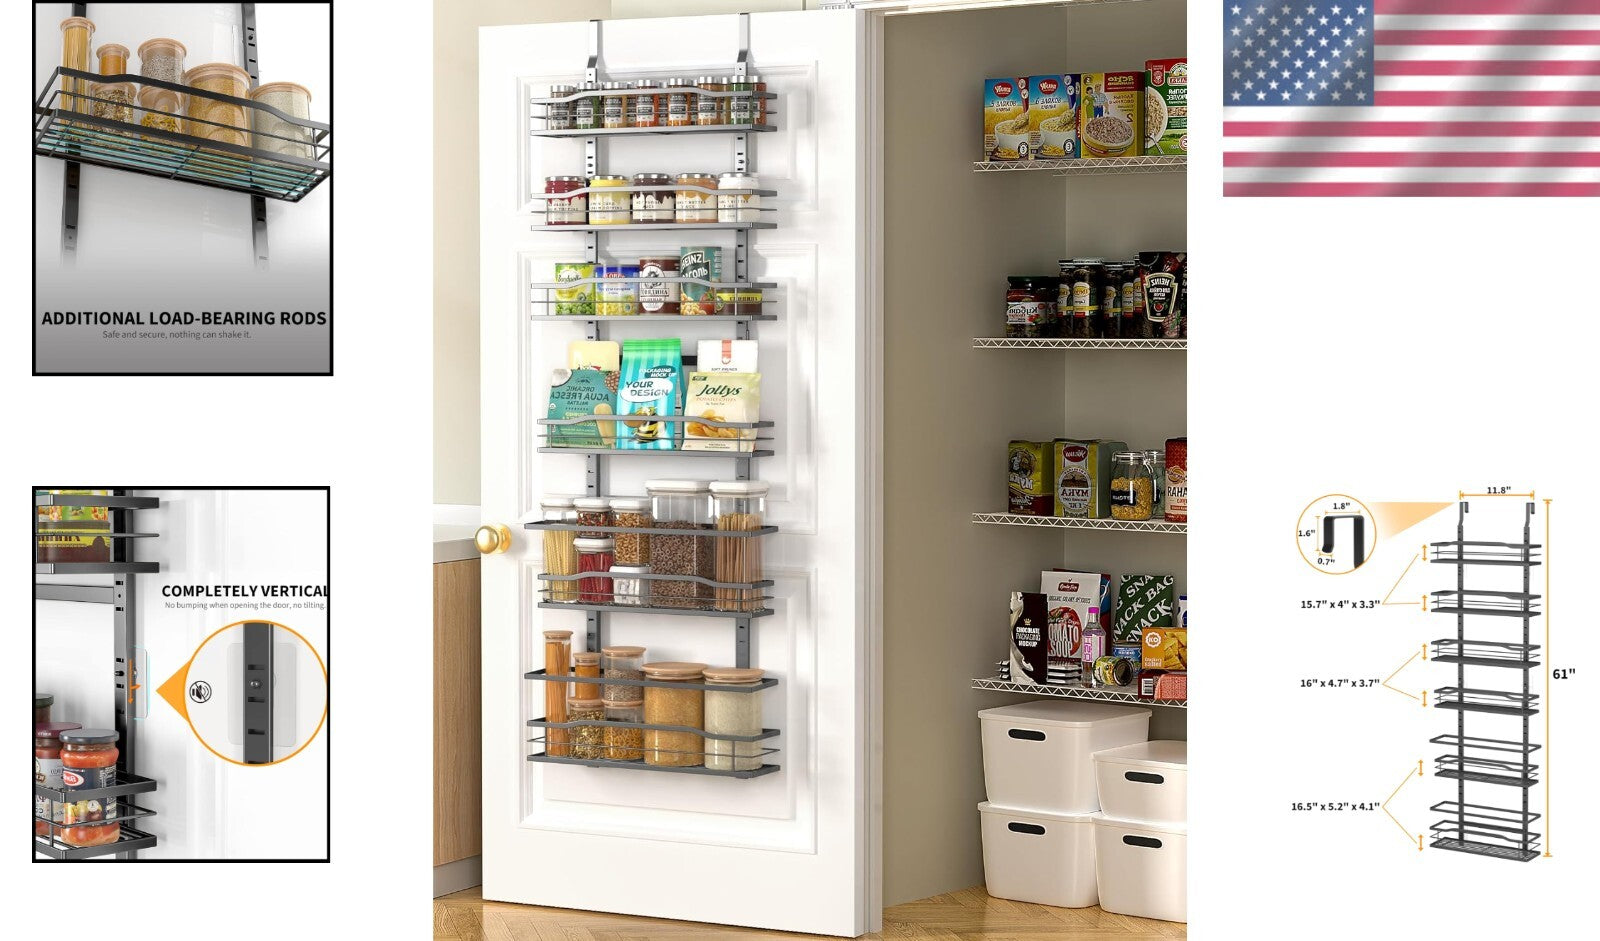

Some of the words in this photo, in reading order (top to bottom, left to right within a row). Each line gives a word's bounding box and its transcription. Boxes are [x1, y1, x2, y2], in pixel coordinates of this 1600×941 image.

[696, 384, 743, 398] Jollys
[1048, 623, 1079, 643] OMATO
[1018, 640, 1038, 648] MOCKUP
[1049, 640, 1073, 657] SOUP
